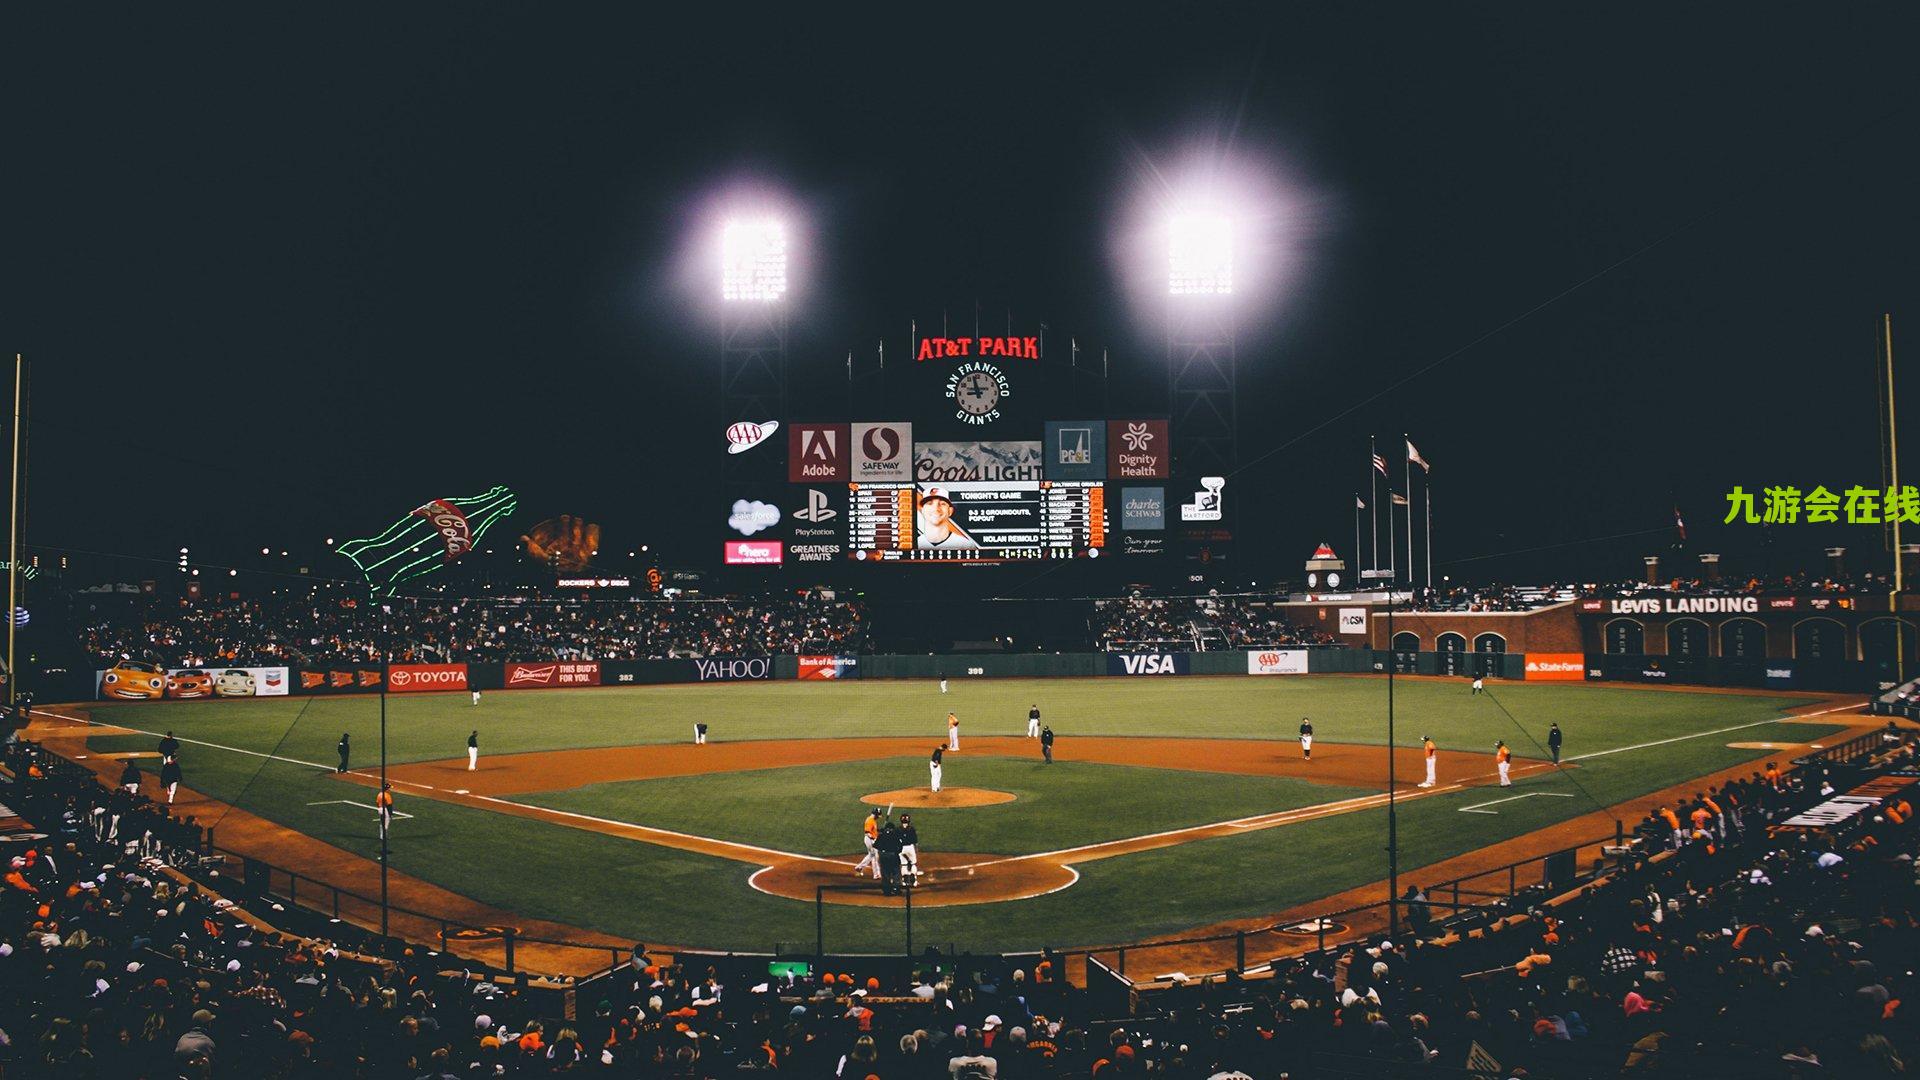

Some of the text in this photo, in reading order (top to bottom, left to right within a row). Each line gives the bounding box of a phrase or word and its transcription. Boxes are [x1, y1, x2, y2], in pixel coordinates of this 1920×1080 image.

[917, 336, 1039, 361] AT&T PARK
[945, 361, 1010, 398] SAN FRANCISCO
[956, 409, 1001, 425] GIANTS
[1061, 450, 1089, 463] PG&E
[1119, 454, 1157, 466] Dignity
[802, 464, 836, 476] Adobe
[862, 462, 899, 470] SAFEWAY
[915, 459, 1043, 481] Coors LIGHT
[1121, 467, 1156, 476] Health
[1126, 499, 1160, 509] charles
[795, 529, 835, 537] PlayStation
[791, 545, 840, 553] GREATNESS
[799, 553, 832, 561] AWAITS
[1666, 598, 1758, 613] LANDING
[1350, 616, 1364, 625] CSN
[800, 658, 856, 666] Bank of America
[1119, 654, 1176, 674] VISA
[559, 665, 598, 673] THIS BUD'S
[695, 658, 770, 681] YAHOO!
[413, 671, 466, 683] TOYOTA
[559, 674, 590, 683] FOR YOU.
